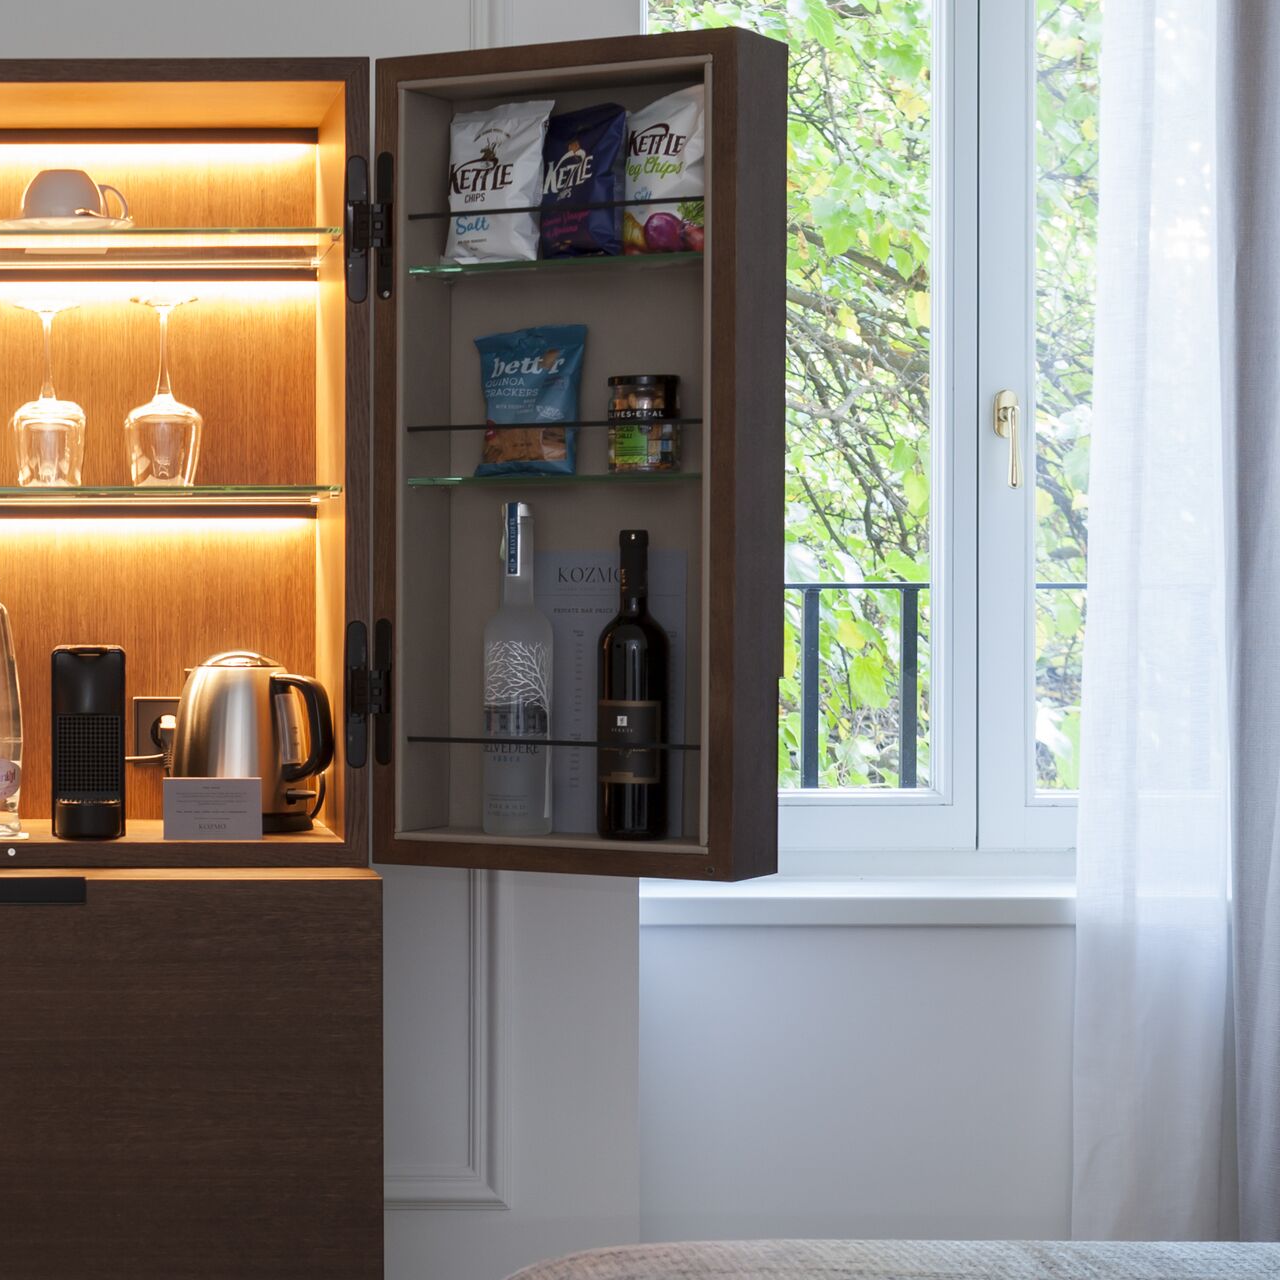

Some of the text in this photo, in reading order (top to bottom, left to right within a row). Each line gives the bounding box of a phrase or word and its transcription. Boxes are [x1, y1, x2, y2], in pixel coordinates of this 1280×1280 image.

[628, 123, 686, 157] KETTLE
[449, 158, 513, 194] KETTLE
[644, 156, 683, 179] Chips
[464, 192, 486, 204] CHIPS
[455, 215, 489, 235] Salt
[485, 377, 524, 387] QUINOA
[485, 388, 539, 399] CRACKERS
